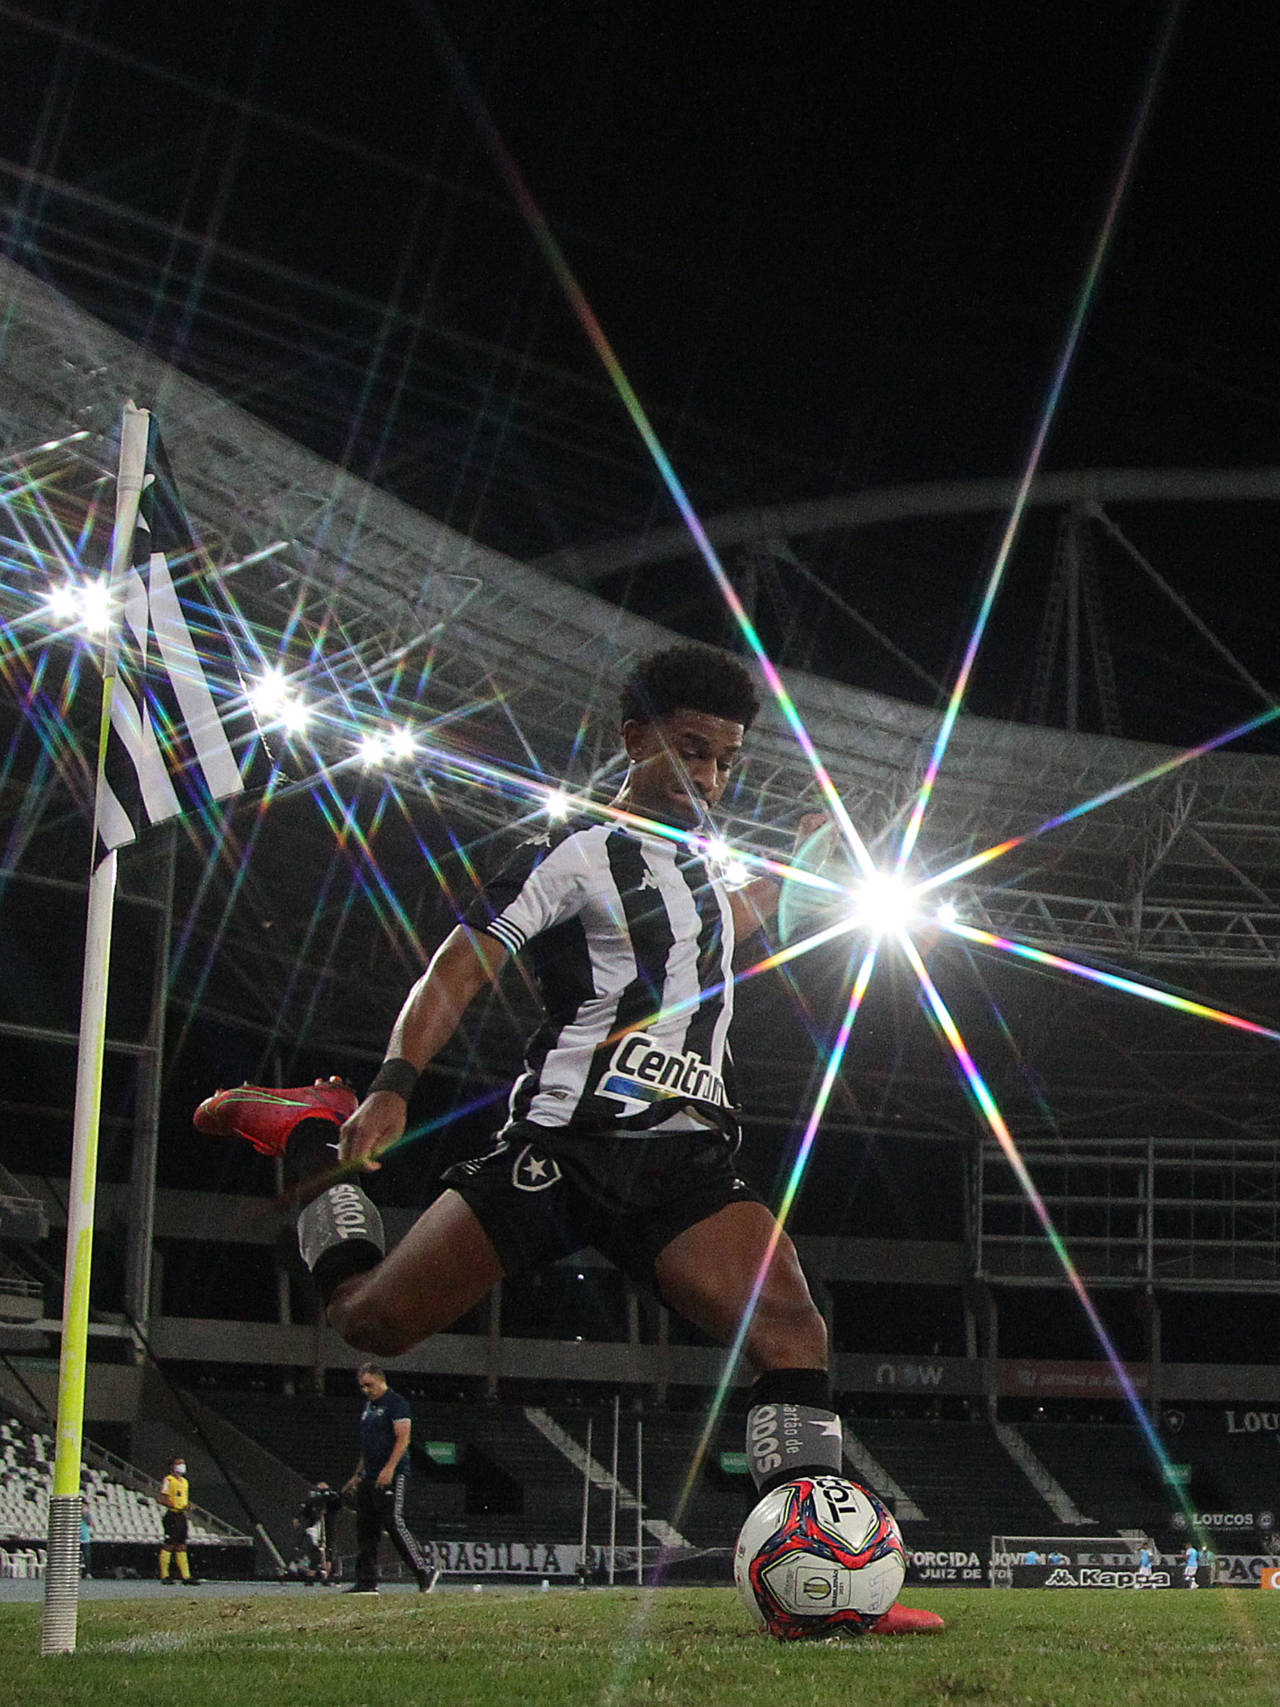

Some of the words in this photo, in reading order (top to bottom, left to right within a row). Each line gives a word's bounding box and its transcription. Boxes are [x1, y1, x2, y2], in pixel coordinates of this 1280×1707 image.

[783, 1404, 803, 1436] artão
[752, 1403, 782, 1474] ODOS
[1193, 1512, 1254, 1525] LOUCOS
[920, 1568, 957, 1579] JUIZ
[963, 1568, 982, 1579] DE
[1080, 1568, 1171, 1589] Kappa
